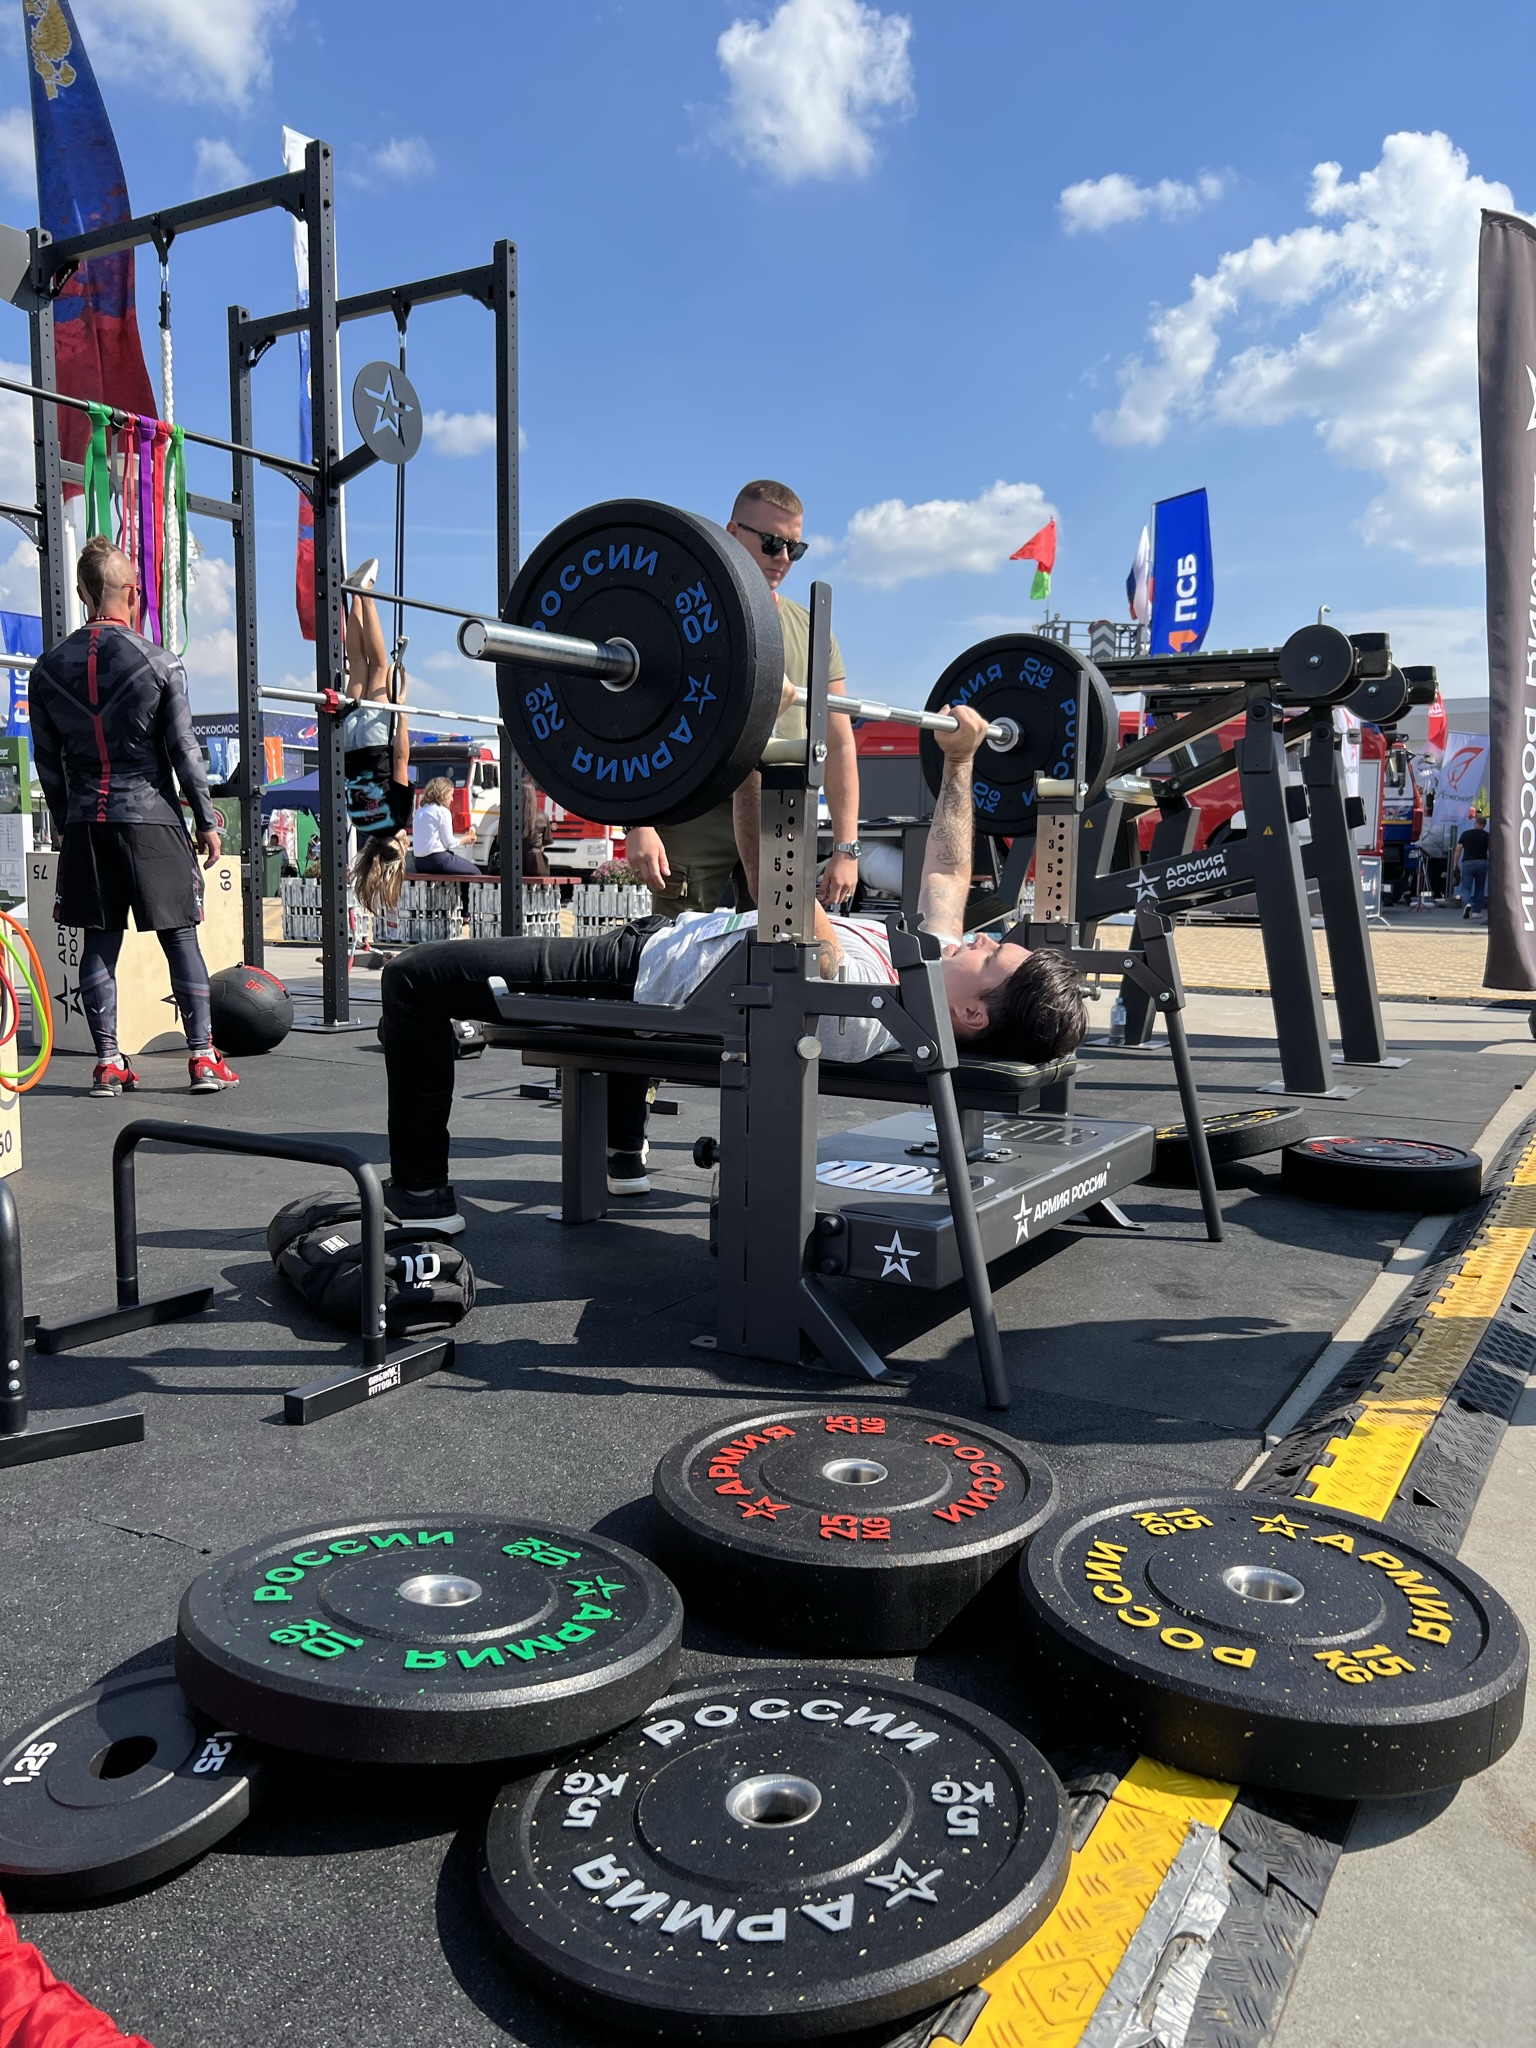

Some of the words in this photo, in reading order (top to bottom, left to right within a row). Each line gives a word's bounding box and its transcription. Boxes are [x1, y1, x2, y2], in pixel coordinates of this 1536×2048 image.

[675, 581, 708, 614] KG
[1174, 553, 1198, 623] ПСБ
[682, 602, 719, 644] 20
[952, 663, 1003, 706] МИЯ
[1019, 657, 1040, 686] 20
[1035, 665, 1054, 689] KG
[525, 682, 553, 713] KG
[531, 700, 565, 740] 20
[571, 715, 696, 783] АРМИЯ
[775, 823, 783, 839] 3
[1050, 815, 1056, 826] 1
[1519, 707, 1536, 931] РОССИИ
[1048, 839, 1055, 849] 3
[33, 864, 48, 880] 75
[774, 857, 782, 872] 5
[1047, 863, 1053, 873] 5
[1165, 853, 1225, 879] АРМИЯ
[219, 869, 232, 891] 60
[1047, 886, 1053, 897] 7
[1166, 866, 1228, 891] РОССИИ
[774, 891, 781, 906] 7
[1045, 910, 1052, 920] 9
[1033, 1188, 1070, 1222] АРМИЯ
[1071, 1171, 1107, 1203] РОССИИ
[401, 1254, 440, 1282] 10
[826, 1415, 858, 1434] 25
[861, 1417, 886, 1434] KG
[708, 1425, 796, 1495] АРМИЯ
[925, 1433, 1005, 1523] РОССИИ
[819, 1514, 858, 1541] 25
[862, 1517, 890, 1541] KG
[1131, 1512, 1178, 1536] KG
[1162, 1507, 1214, 1530] 15
[502, 1537, 551, 1558] KG
[530, 1546, 582, 1567] 10
[253, 1531, 455, 1602] РОССИИ
[1311, 1532, 1454, 1646] АРМИЯ
[1084, 1540, 1257, 1669] РОССИИ
[269, 1618, 332, 1645] KG
[300, 1631, 364, 1659] 10
[403, 1602, 613, 1669] АРМИЯ
[1313, 1650, 1374, 1684] KG
[1351, 1644, 1417, 1677] 15
[642, 1698, 940, 1753] РОССИИ
[562, 1771, 627, 1797] KG
[930, 1780, 996, 1806] KG
[562, 1797, 602, 1828] 5
[946, 1805, 980, 1837] 5
[571, 1853, 855, 1943] АРМИЯ
